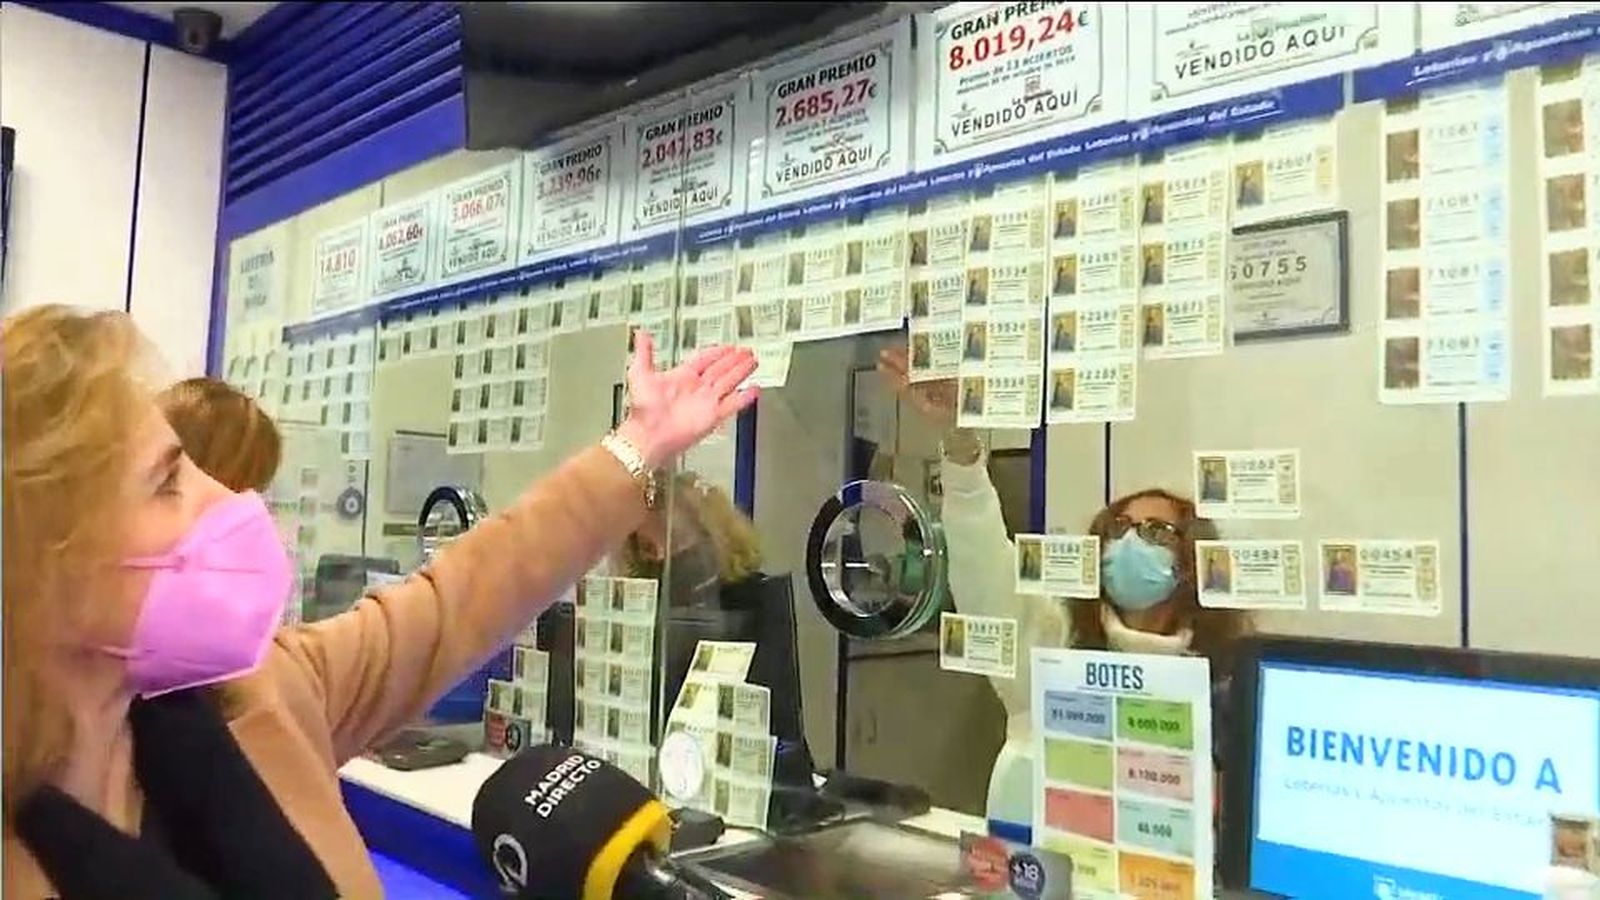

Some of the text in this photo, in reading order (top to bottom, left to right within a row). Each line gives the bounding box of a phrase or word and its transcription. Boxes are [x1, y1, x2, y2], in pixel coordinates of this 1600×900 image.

[951, 10, 1000, 41] GRAN
[777, 53, 877, 99] GRAN PREMIO
[1176, 40, 1275, 79] VENDIDO
[646, 121, 677, 142] GRAN
[951, 103, 1027, 138] VENDIDO
[565, 144, 602, 169] PREMIO
[775, 156, 834, 183] VENDIDO
[1085, 660, 1145, 691] BOTES
[1286, 724, 1563, 795] BIENVENIDO A
[524, 755, 585, 806] MADRID
[536, 760, 602, 818] DIRECTO
